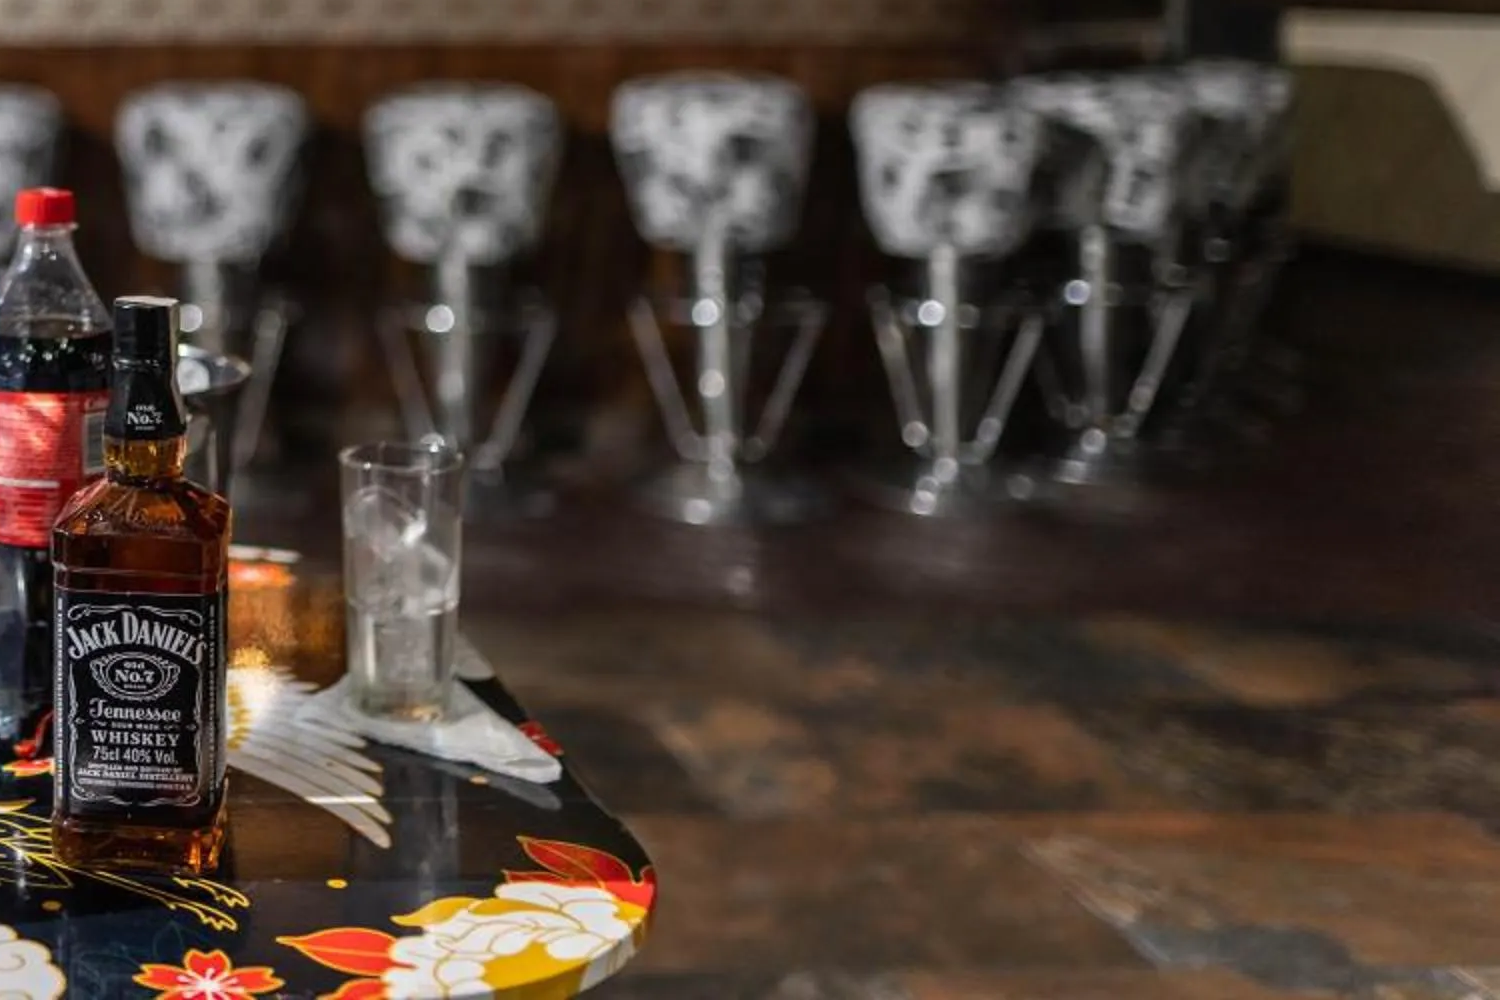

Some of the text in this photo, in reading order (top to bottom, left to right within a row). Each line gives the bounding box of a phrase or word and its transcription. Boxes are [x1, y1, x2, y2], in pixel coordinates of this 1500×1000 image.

[66, 610, 207, 665] JACK DANIEL'S
[89, 697, 181, 722] Tennessee
[91, 729, 180, 748] WHISKEY
[92, 745, 179, 765] 75cl 40% Vol.
